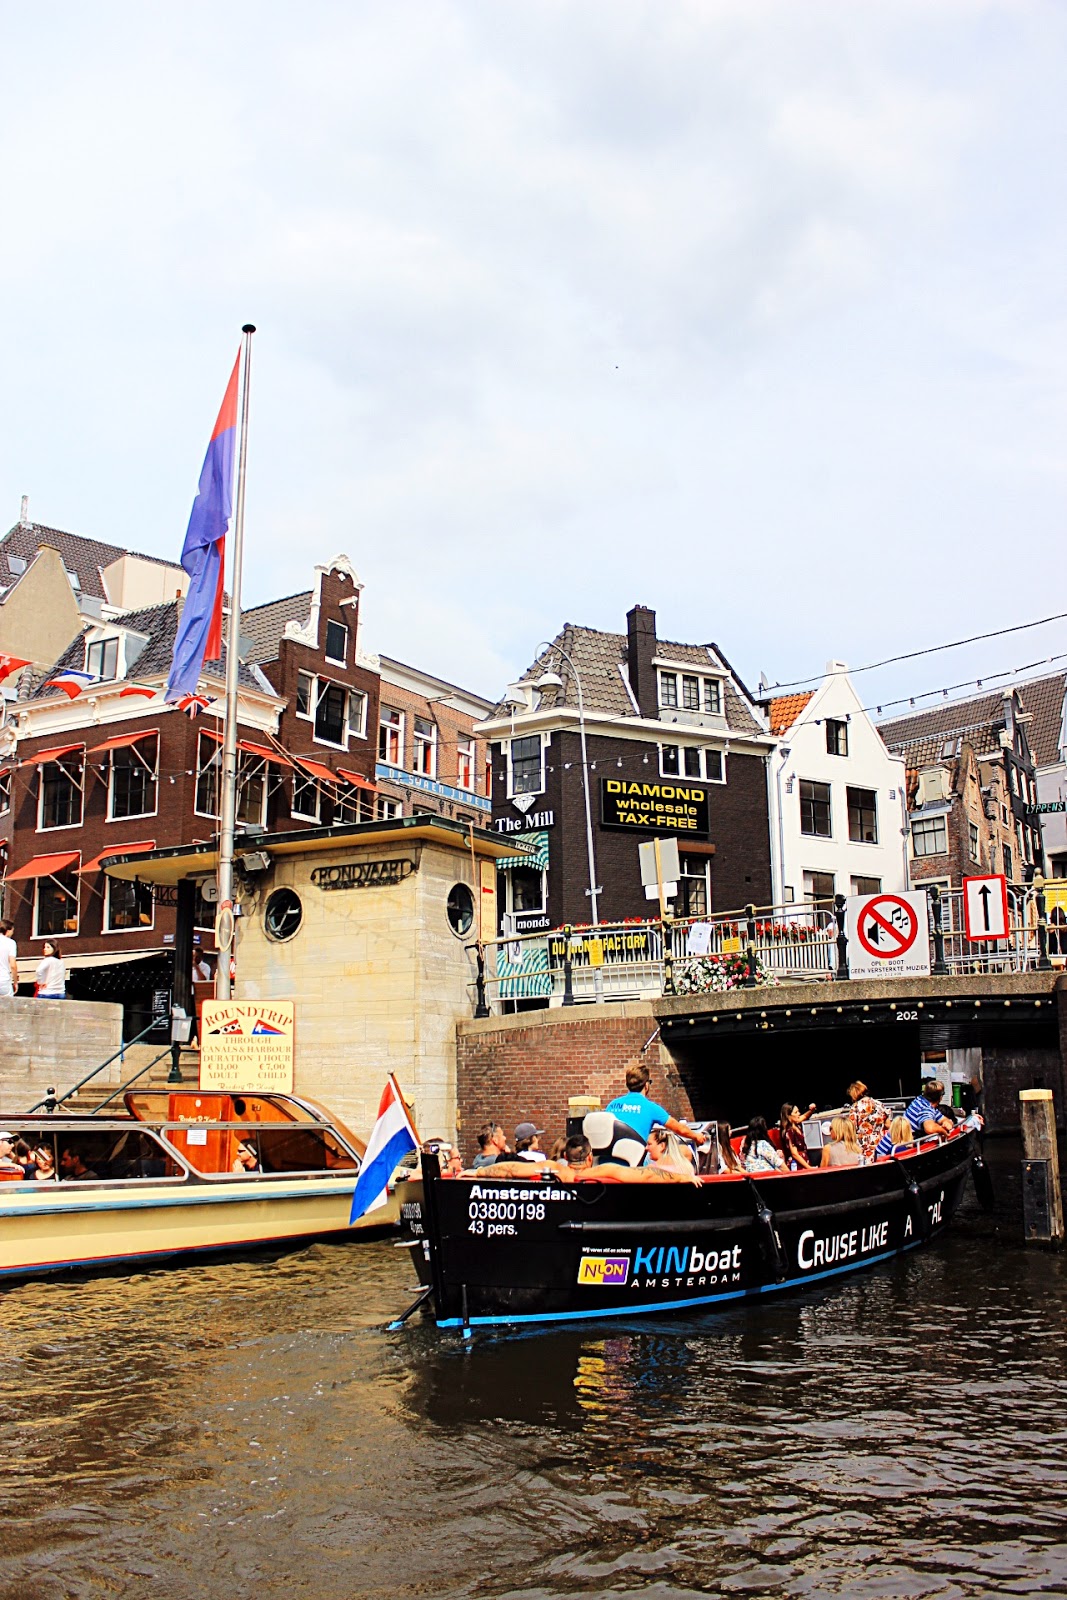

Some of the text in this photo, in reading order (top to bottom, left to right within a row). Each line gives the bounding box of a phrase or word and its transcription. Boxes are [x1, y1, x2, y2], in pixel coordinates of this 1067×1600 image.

[408, 774, 444, 793] SWAEN
[606, 780, 705, 802] DIAMOND
[616, 798, 698, 815] wholesale
[1026, 802, 1063, 814] LYPPENS
[495, 810, 554, 832] The Mill
[616, 811, 698, 829] TAX-FREE
[603, 935, 647, 951] FACTORY
[867, 965, 905, 974] VERSTERKTE
[205, 1006, 292, 1027] ROUNDTRIP
[896, 1010, 919, 1021] 202
[247, 1045, 292, 1053] HARBOUR
[468, 1202, 546, 1220] 03800198
[468, 1220, 518, 1237] 43 pers.
[798, 1230, 858, 1269] CRUISE
[861, 1221, 888, 1252] LIKE
[584, 1264, 624, 1277] NUON
[631, 1273, 741, 1288] AMSTERDAM
